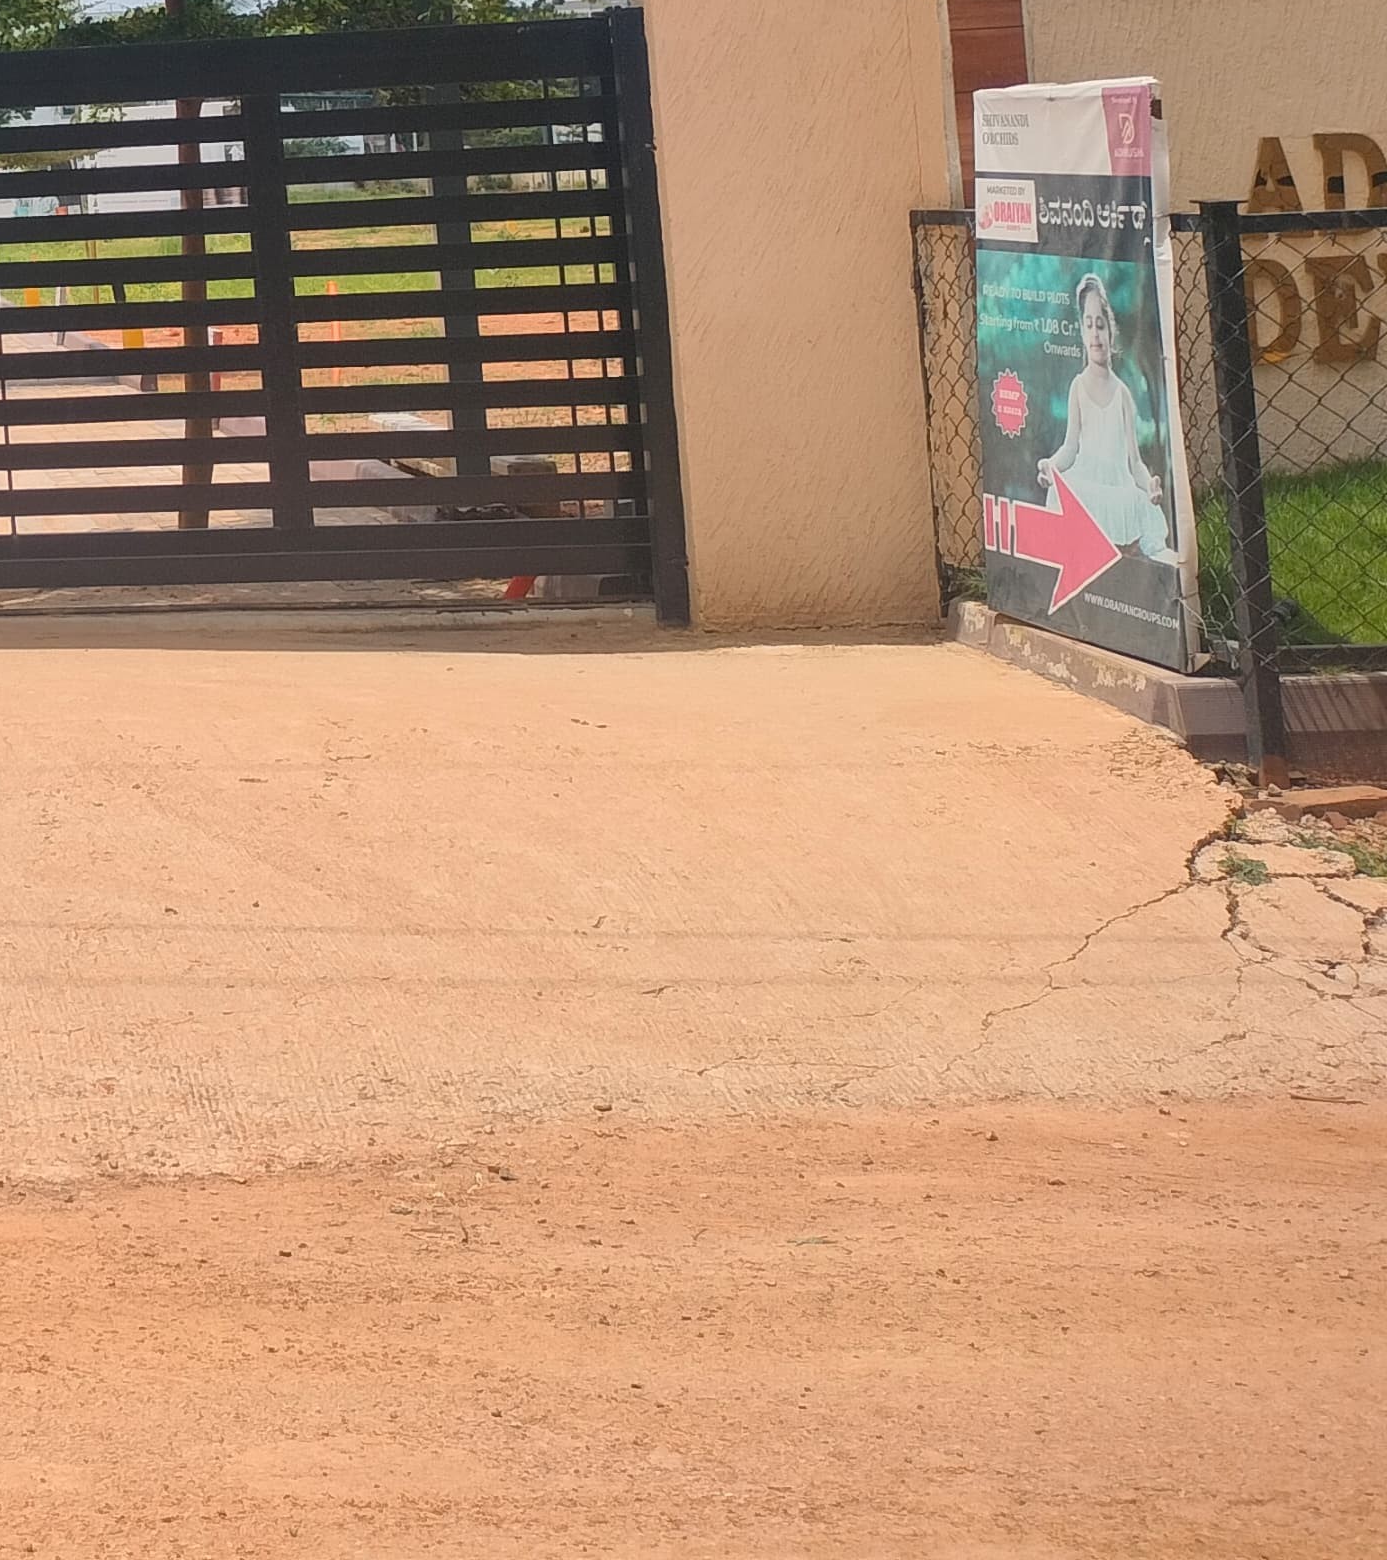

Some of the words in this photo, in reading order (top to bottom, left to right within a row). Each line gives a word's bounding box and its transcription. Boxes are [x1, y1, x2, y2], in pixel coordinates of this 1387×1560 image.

[994, 201, 1032, 225] ORAIYAN
[1242, 252, 1387, 366] DE
[1043, 340, 1082, 358] Onwards
